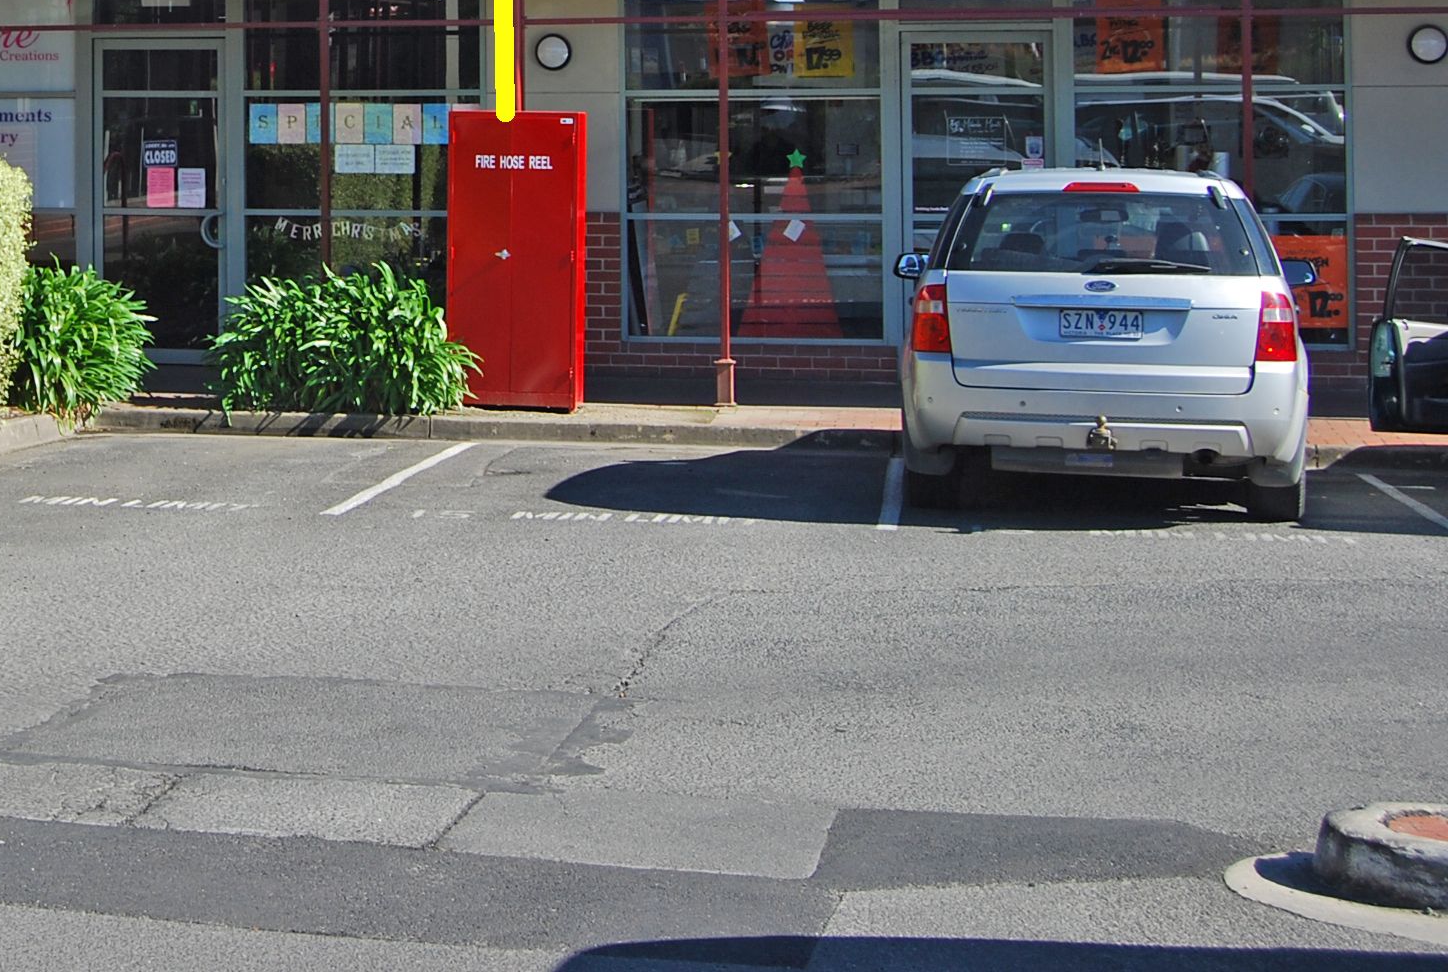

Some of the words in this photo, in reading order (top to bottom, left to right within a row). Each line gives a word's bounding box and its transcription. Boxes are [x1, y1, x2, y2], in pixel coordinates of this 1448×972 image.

[0, 49, 60, 62] Creations
[144, 149, 176, 165] CLOSED
[475, 154, 496, 169] FIRE
[499, 155, 525, 170] HOSE
[529, 155, 553, 170] REEL
[273, 216, 323, 241] MERR
[1063, 312, 1094, 330] SZN
[1108, 313, 1140, 331] 944
[17, 495, 120, 506] MIN
[410, 508, 476, 519] 15
[510, 511, 613, 522] MIN
